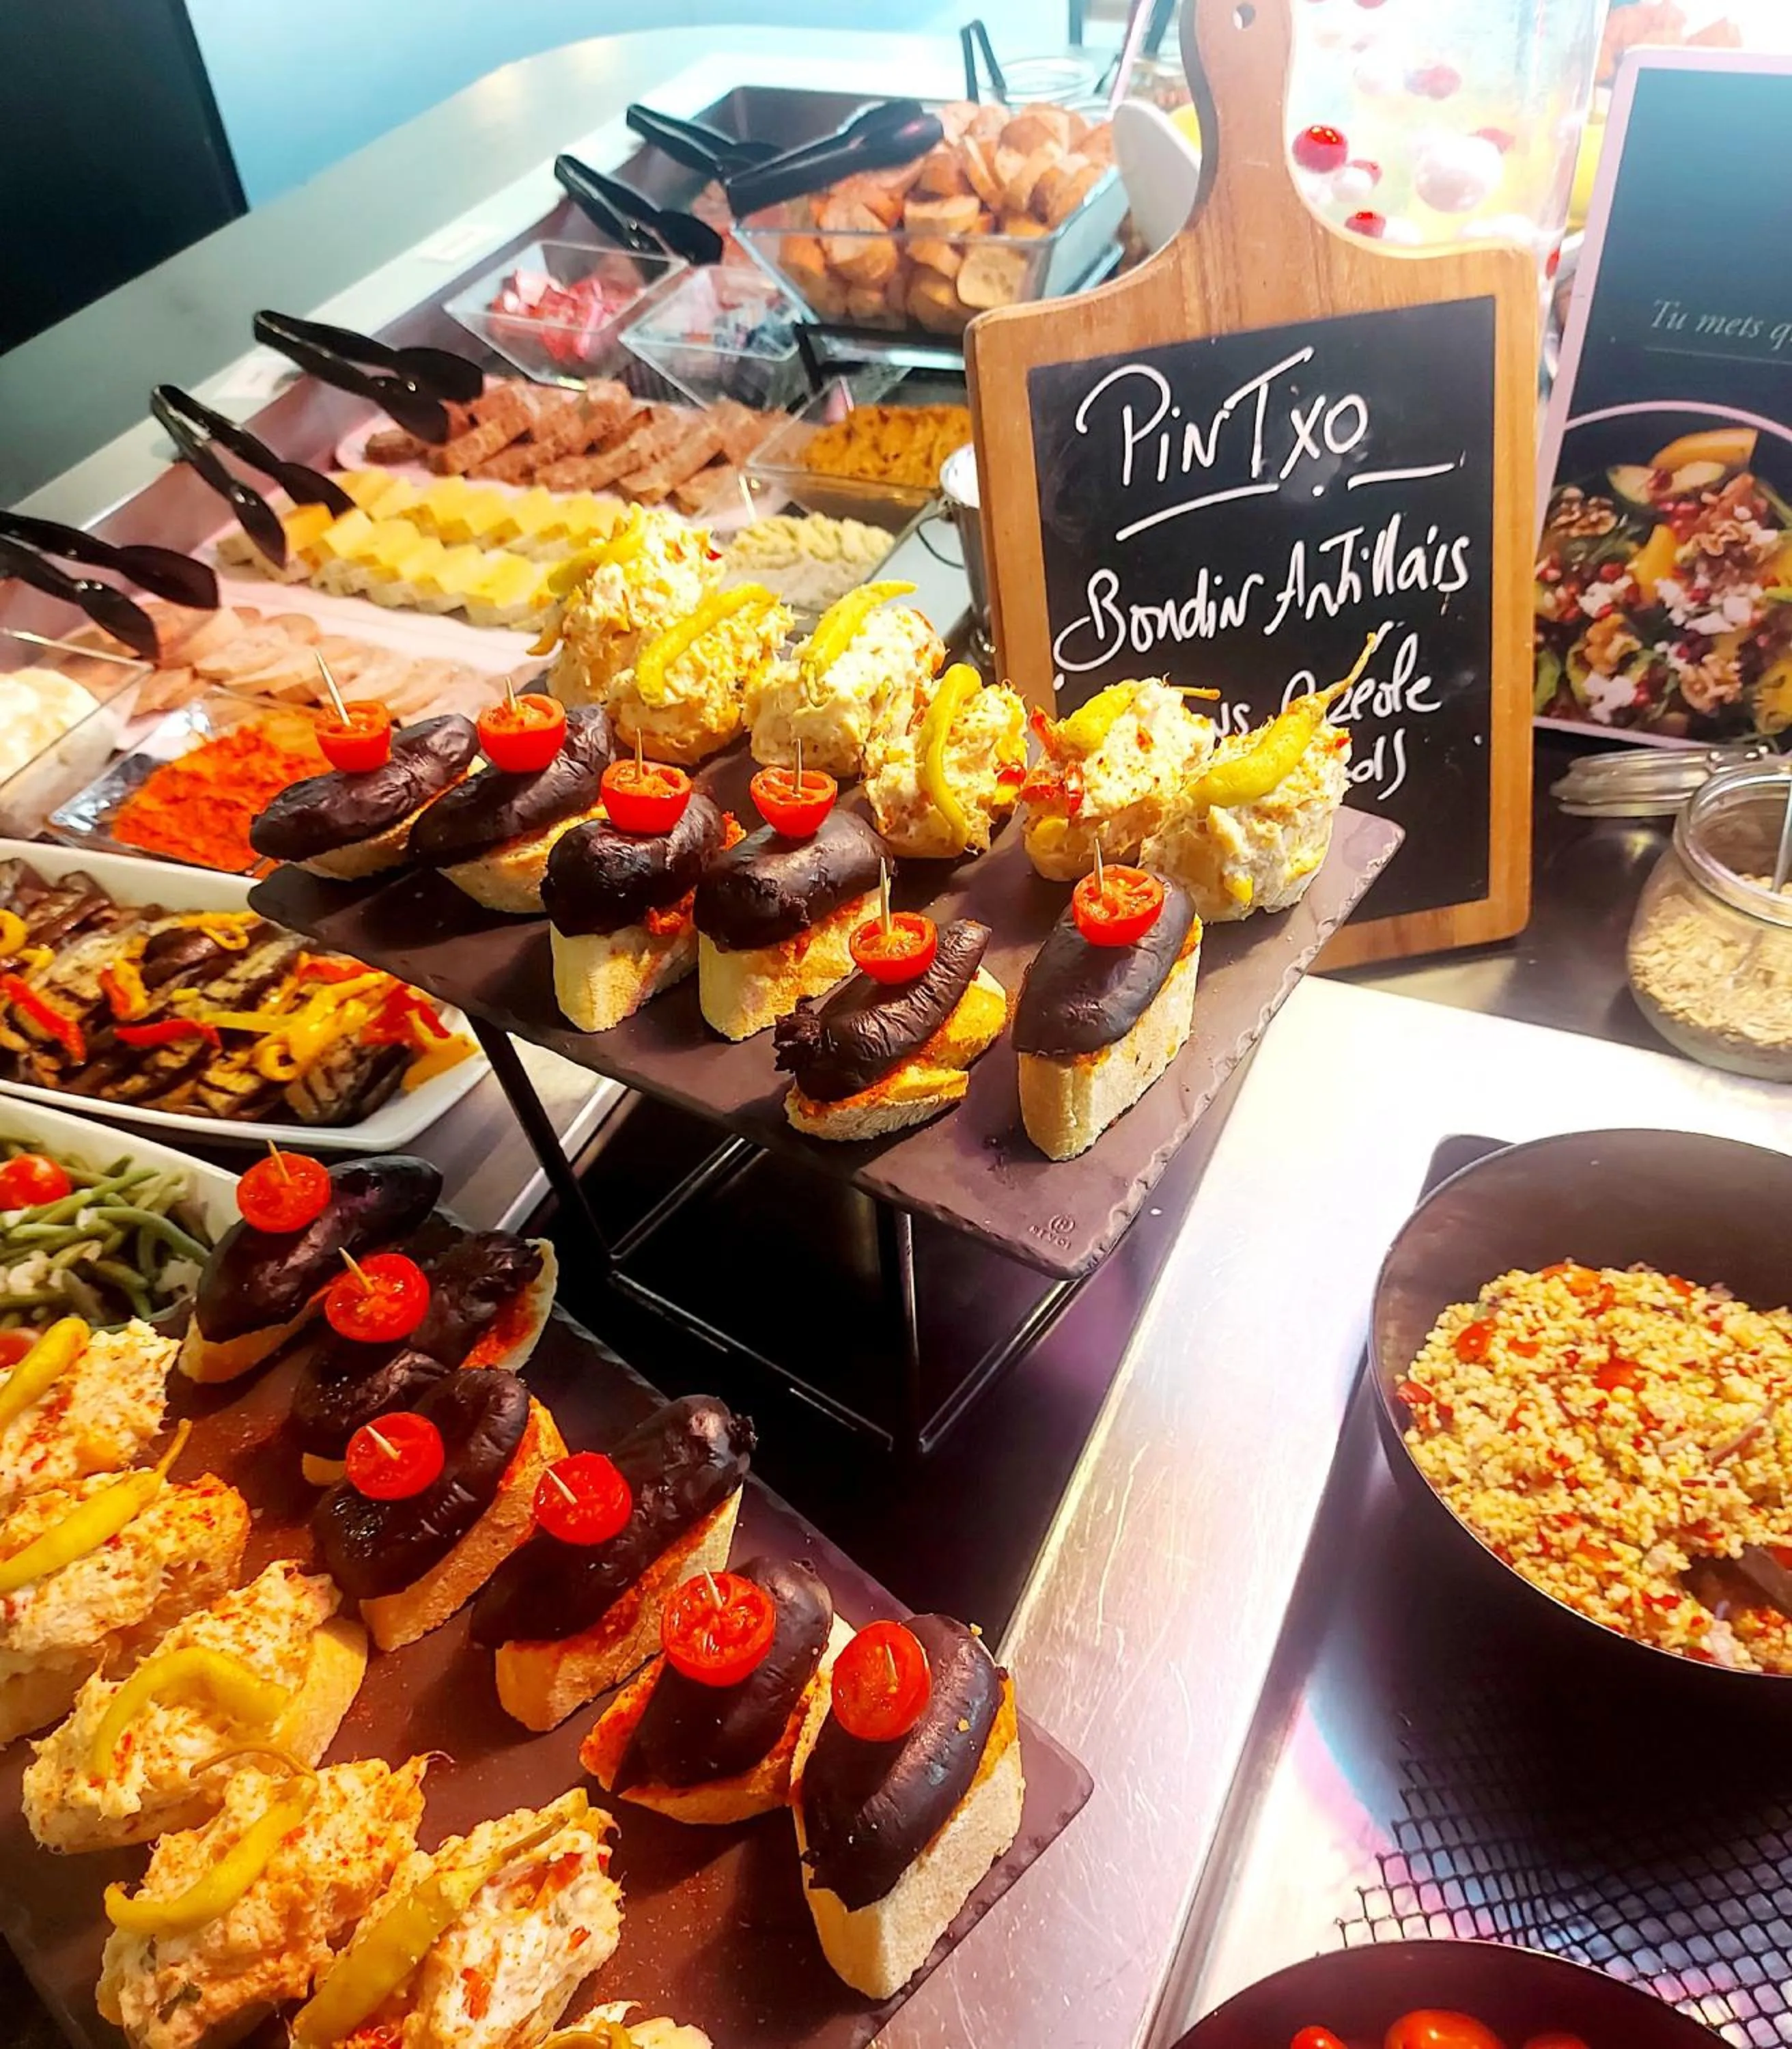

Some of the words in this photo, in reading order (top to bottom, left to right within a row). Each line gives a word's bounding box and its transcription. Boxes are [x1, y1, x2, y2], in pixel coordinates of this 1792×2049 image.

[1651, 298, 1689, 331] Tu
[1695, 313, 1764, 339] mets
[1769, 322, 1792, 351] q
